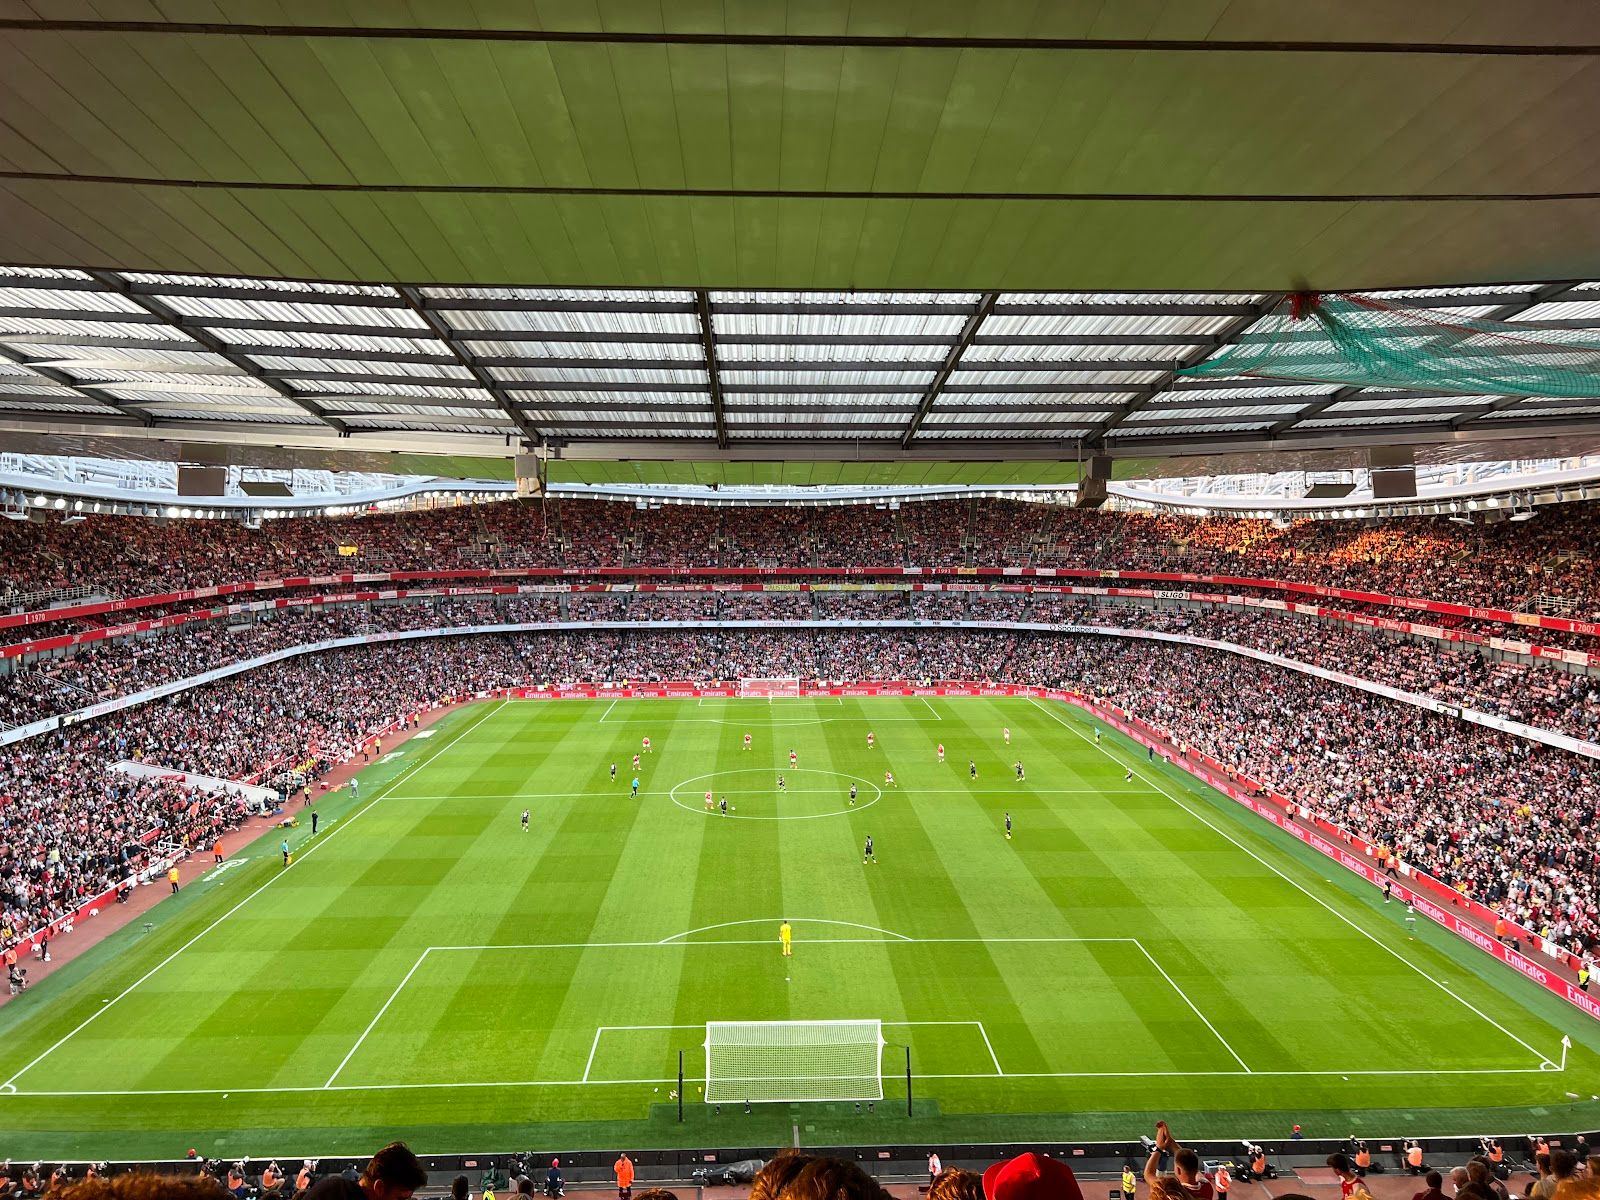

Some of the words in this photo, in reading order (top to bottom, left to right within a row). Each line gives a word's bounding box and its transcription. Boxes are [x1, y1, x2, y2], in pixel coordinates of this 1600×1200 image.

[1161, 591, 1184, 599] SLIGO
[286, 597, 314, 606] Arsenal.com
[31, 613, 46, 622] 1970
[1475, 610, 1489, 618] 2002
[1057, 624, 1100, 634] Sportsbet.io
[1578, 624, 1596, 634] 2002
[1540, 648, 1562, 660] Arsenal
[1283, 819, 1304, 839] Emirates
[1310, 835, 1334, 856] Emirates
[1340, 852, 1367, 876] Emirates
[1411, 894, 1446, 923] Emirates
[1455, 919, 1494, 951] Emirates
[1505, 949, 1547, 984] Emirates
